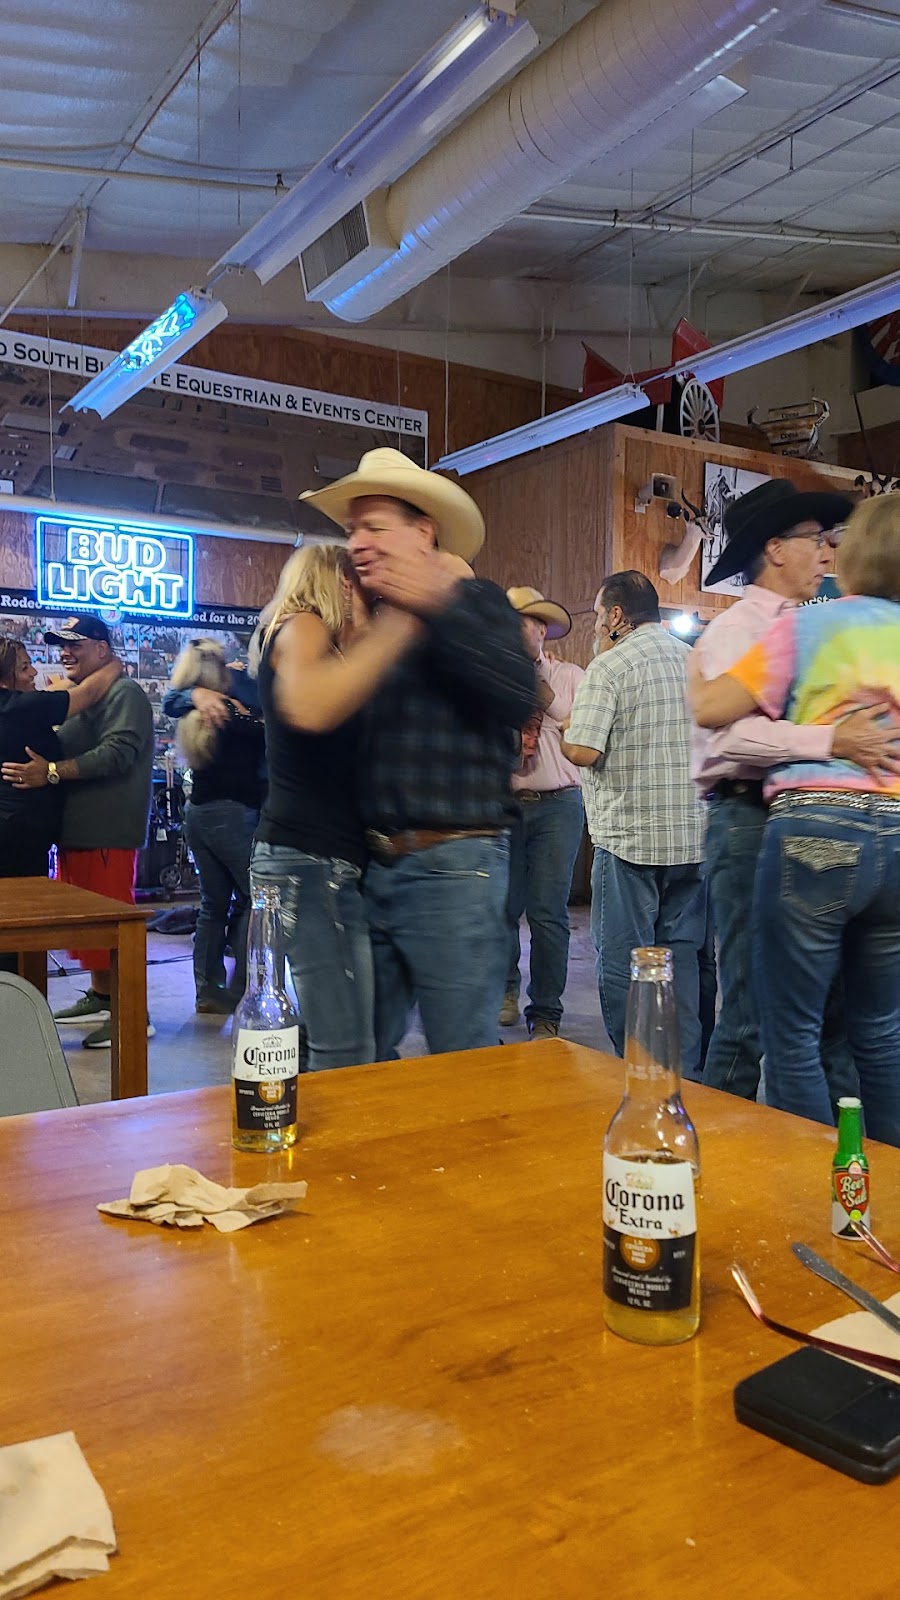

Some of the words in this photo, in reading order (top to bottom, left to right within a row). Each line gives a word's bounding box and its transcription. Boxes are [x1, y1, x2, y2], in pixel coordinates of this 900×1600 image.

[13, 342, 79, 371] SOUTH
[176, 372, 281, 408] EQUESTRIAN
[285, 394, 298, 410] &
[302, 396, 361, 422] EVENTS
[364, 409, 423, 433] CENTER
[67, 527, 167, 573] BUD
[48, 562, 184, 609] LIGHT
[0, 595, 43, 610] Rodeo
[209, 612, 225, 624] for
[227, 614, 245, 626] the
[243, 1046, 296, 1069] Corona
[258, 1064, 287, 1076] Extra
[606, 1178, 686, 1211] Corona
[840, 1176, 865, 1193] Beer
[619, 1207, 663, 1230] Extra
